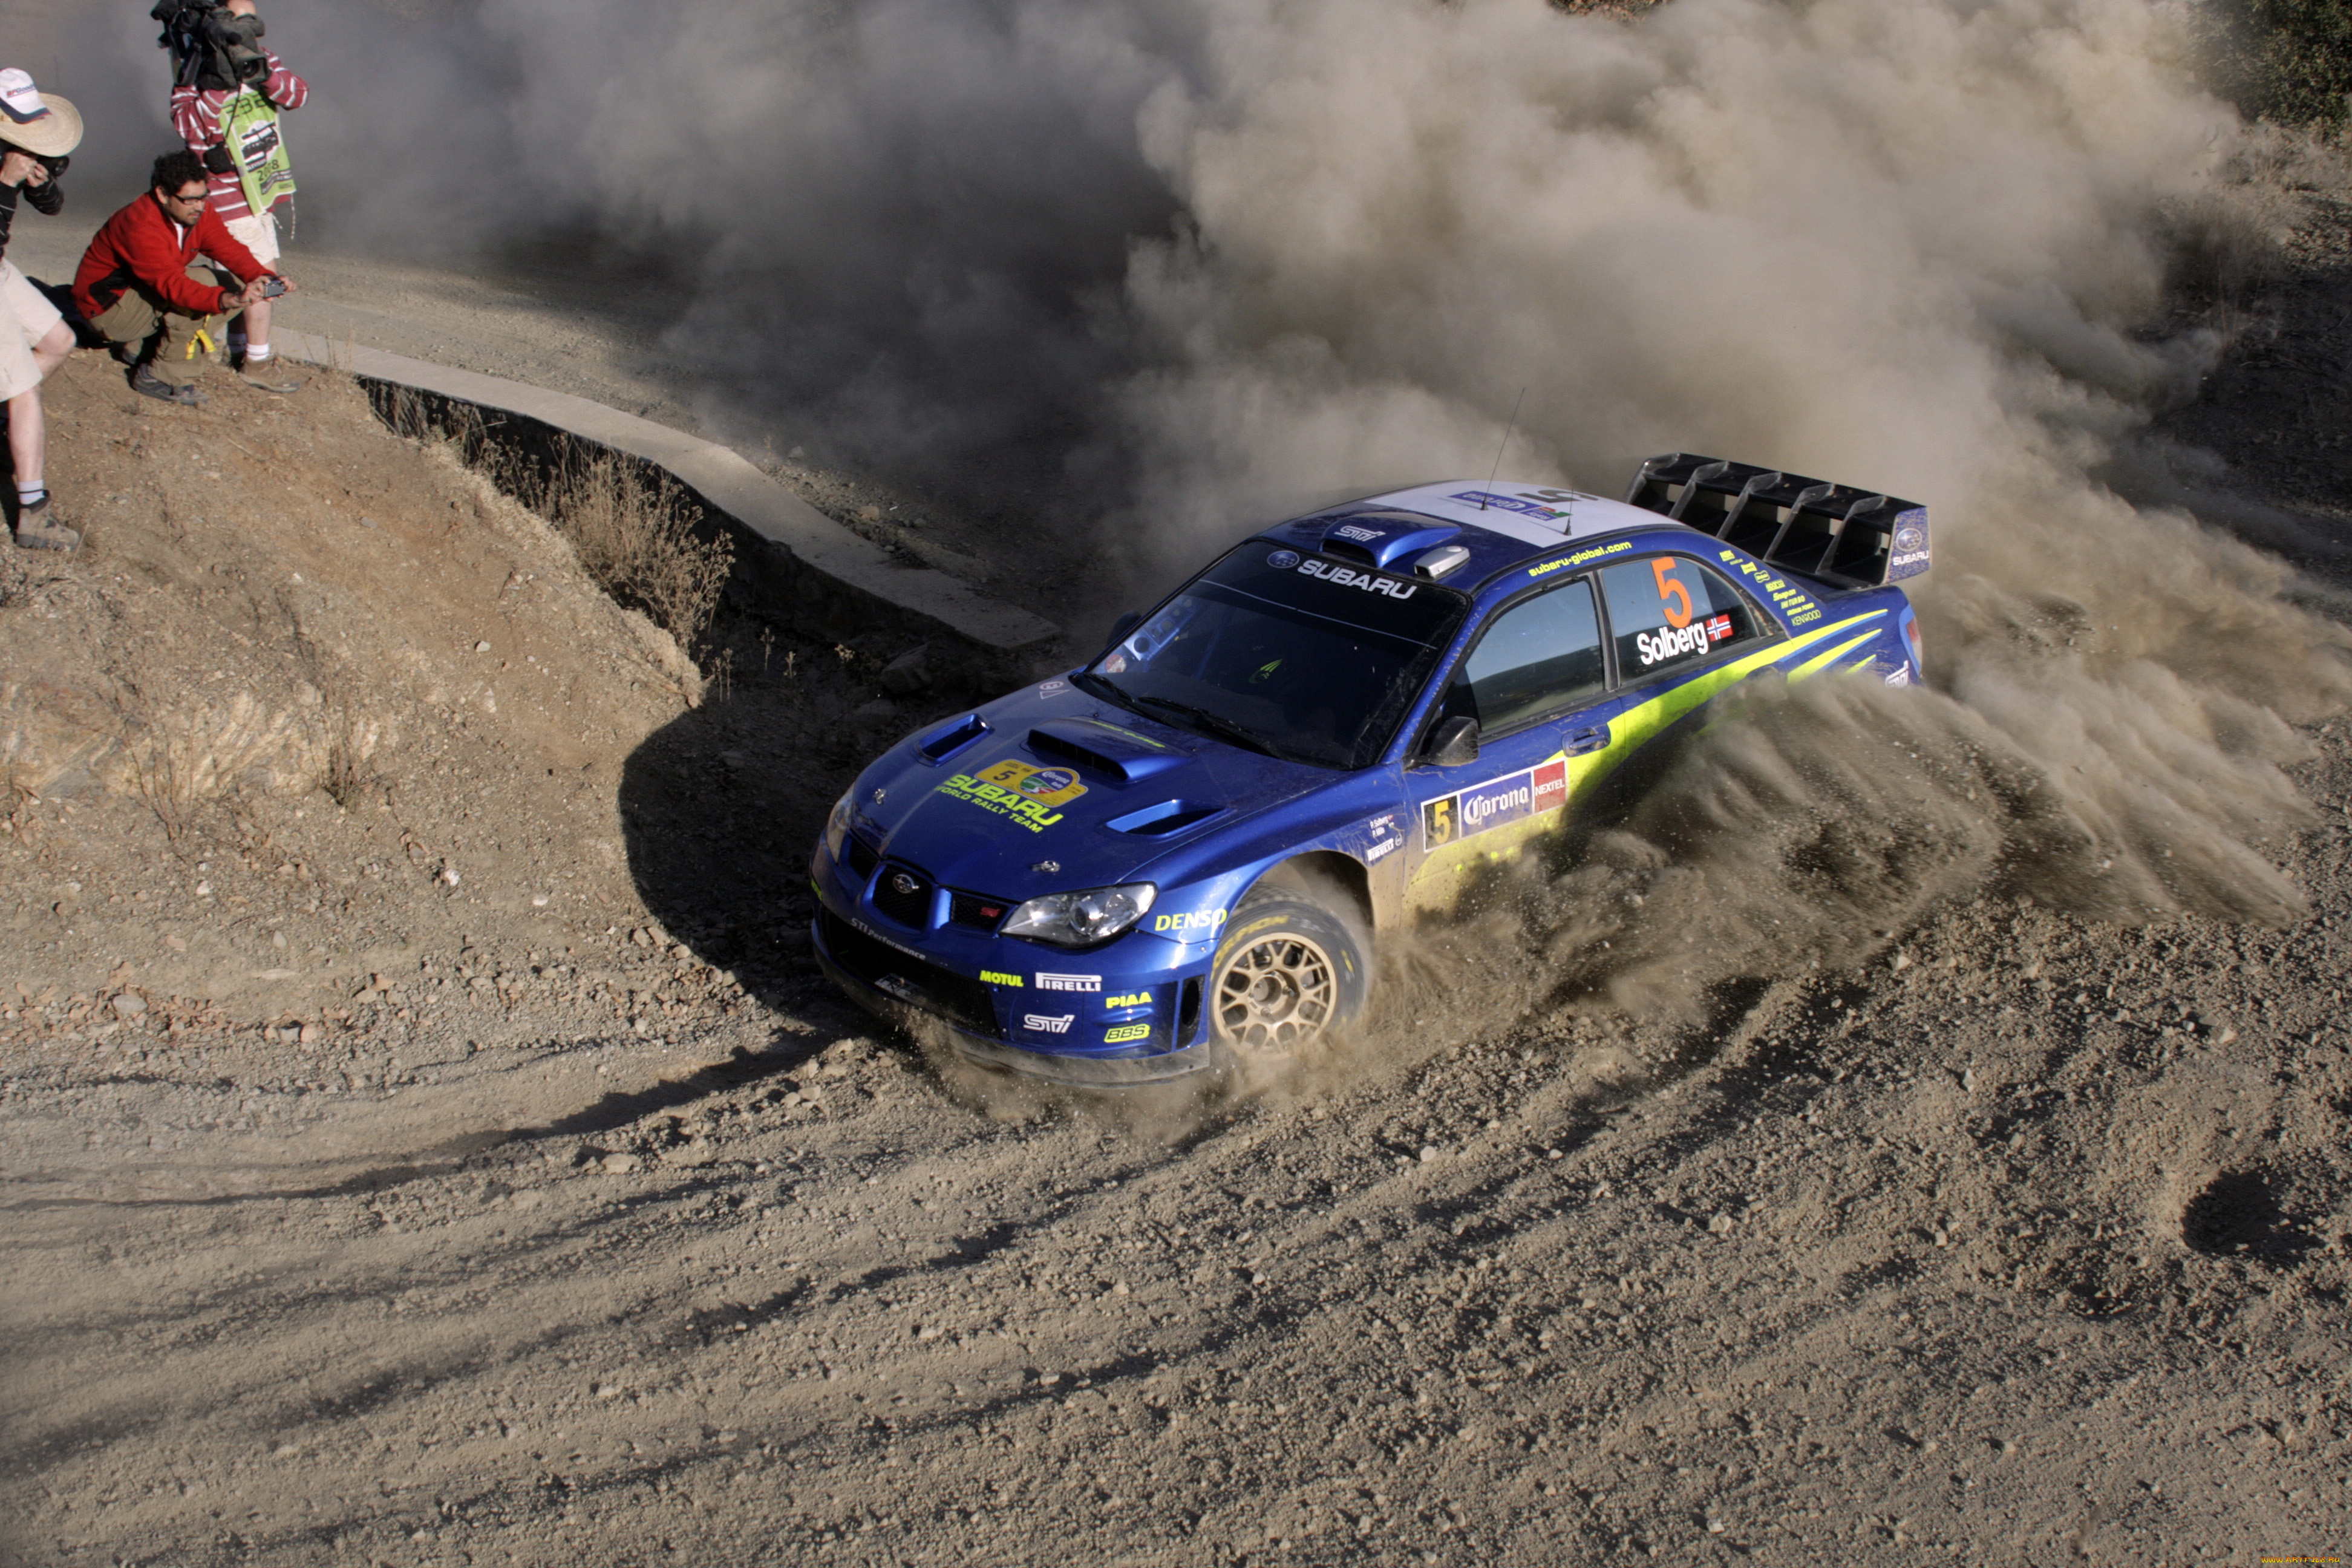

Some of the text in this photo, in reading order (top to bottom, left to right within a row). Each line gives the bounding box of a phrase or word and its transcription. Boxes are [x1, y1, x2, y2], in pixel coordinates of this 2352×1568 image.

[1515, 490, 1599, 503] 5
[1893, 550, 1929, 566] SUBARU
[1298, 560, 1417, 599] SUBARU
[1650, 557, 1693, 629] 5
[1791, 609, 1822, 626] KENWOOD
[1637, 622, 1709, 665] Solberg
[993, 770, 1018, 781] 5
[1535, 778, 1566, 796] NEXTEL
[934, 786, 972, 800] WORLD
[971, 797, 1009, 815] RALLY
[1008, 812, 1044, 834] TEAM
[944, 774, 1064, 826] SUBARU
[1464, 786, 1530, 825] Corona
[1434, 800, 1451, 844] 5
[1367, 838, 1394, 861] PIRELLI
[1155, 908, 1227, 931] DENSO
[851, 917, 926, 961] STI Performance
[979, 970, 1024, 987] MOTUL
[1035, 972, 1102, 992] PIRELLI
[1106, 991, 1152, 1008] PIAA
[1106, 1024, 1147, 1040] BBS
